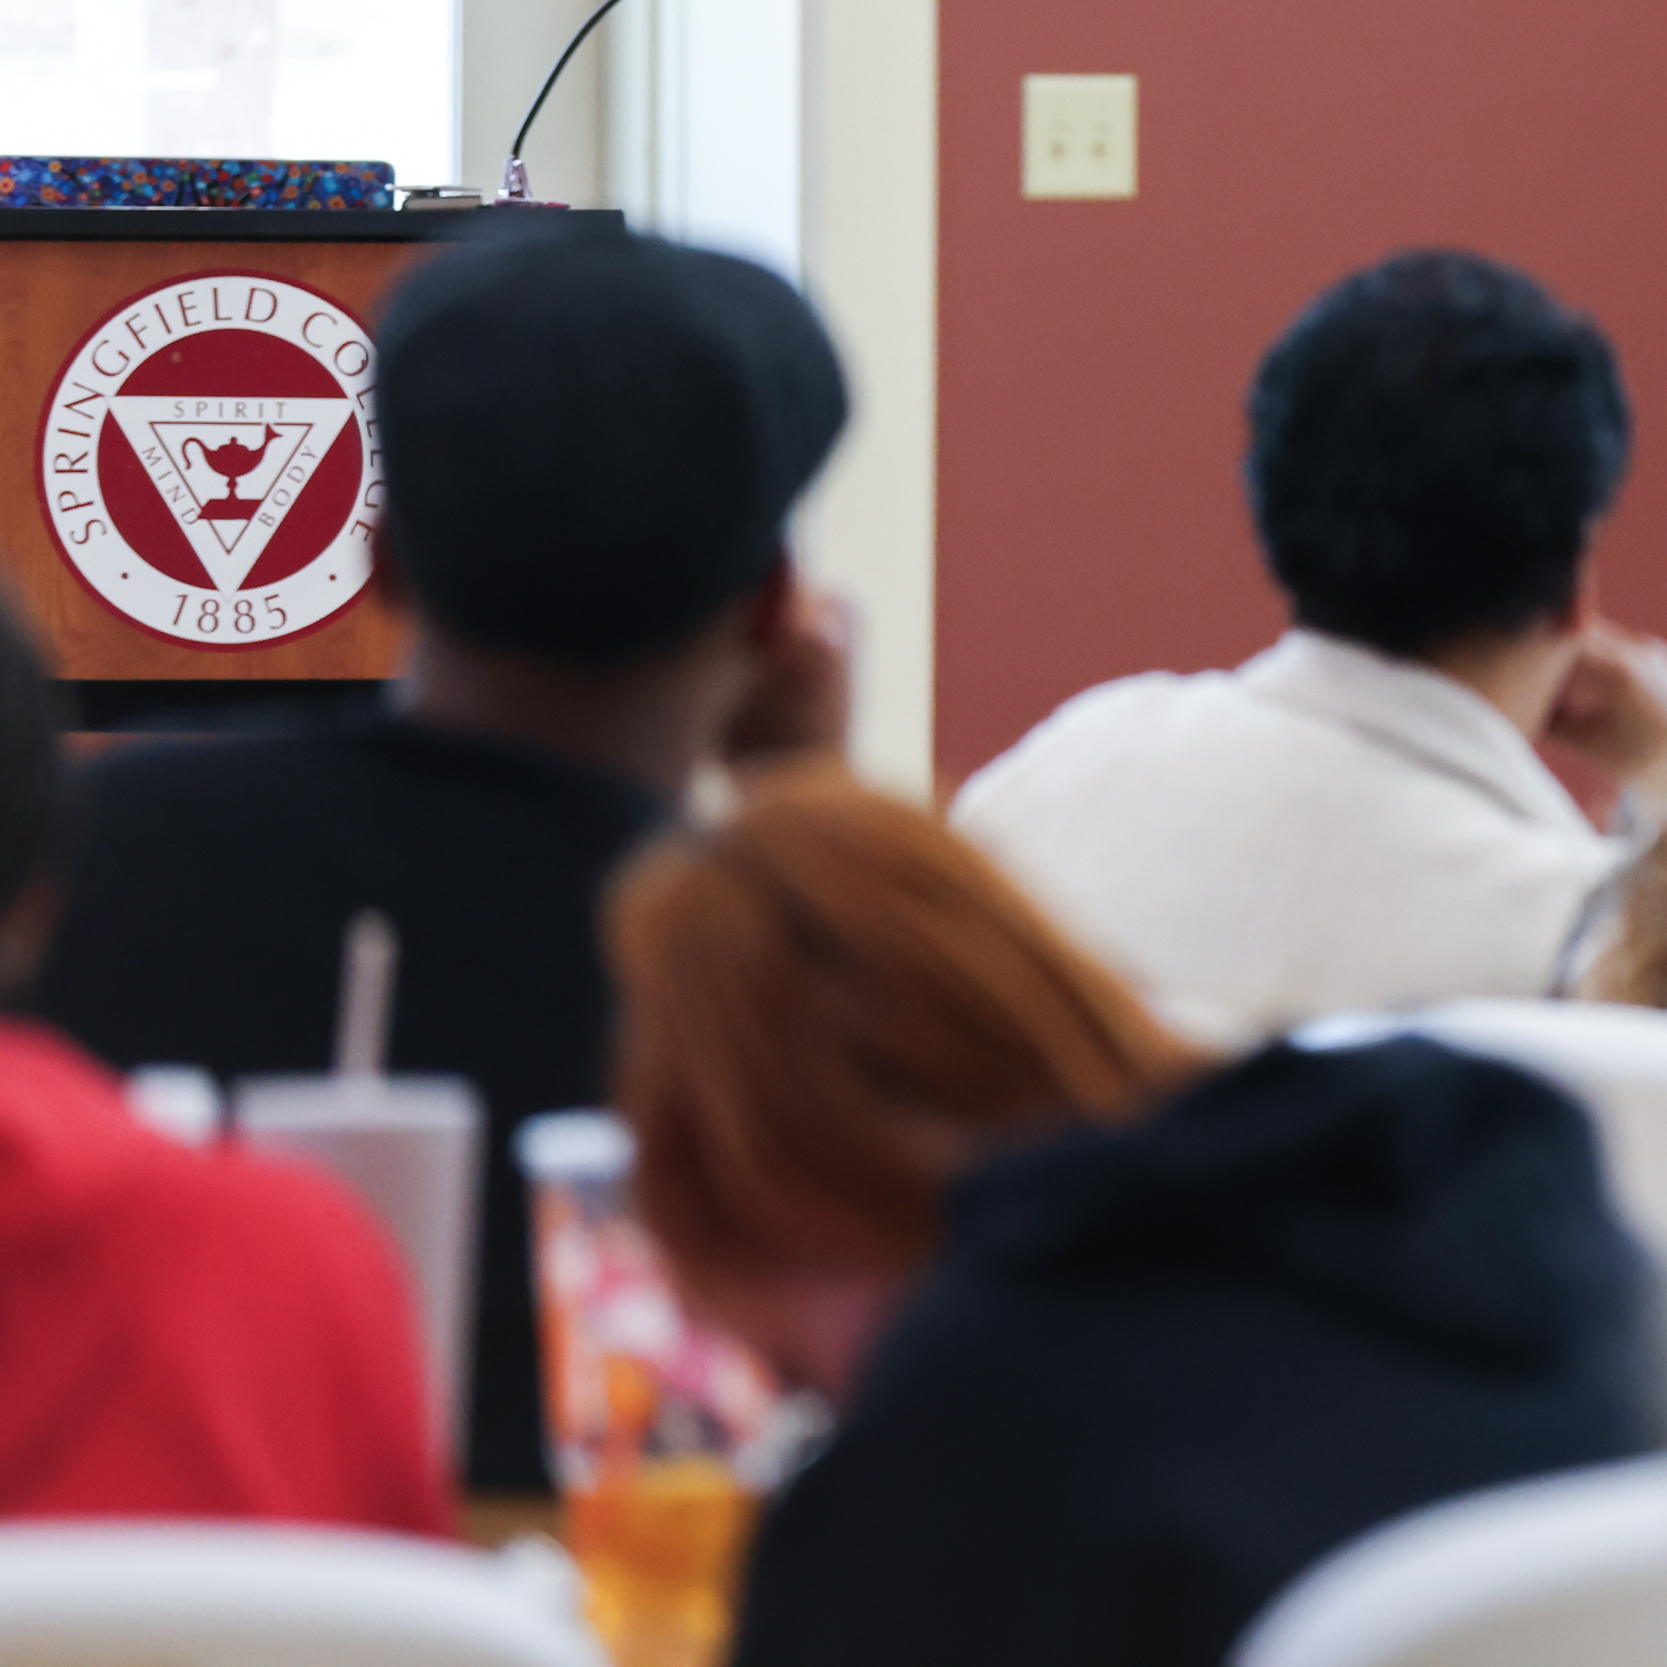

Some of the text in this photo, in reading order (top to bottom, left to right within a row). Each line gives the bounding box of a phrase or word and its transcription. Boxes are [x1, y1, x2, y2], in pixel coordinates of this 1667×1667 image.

[53, 287, 279, 546] SPRINGFIELD
[173, 400, 287, 419] SPIRIT
[142, 445, 199, 526] MIND
[258, 445, 318, 528] BODY
[170, 593, 288, 635] 1885
